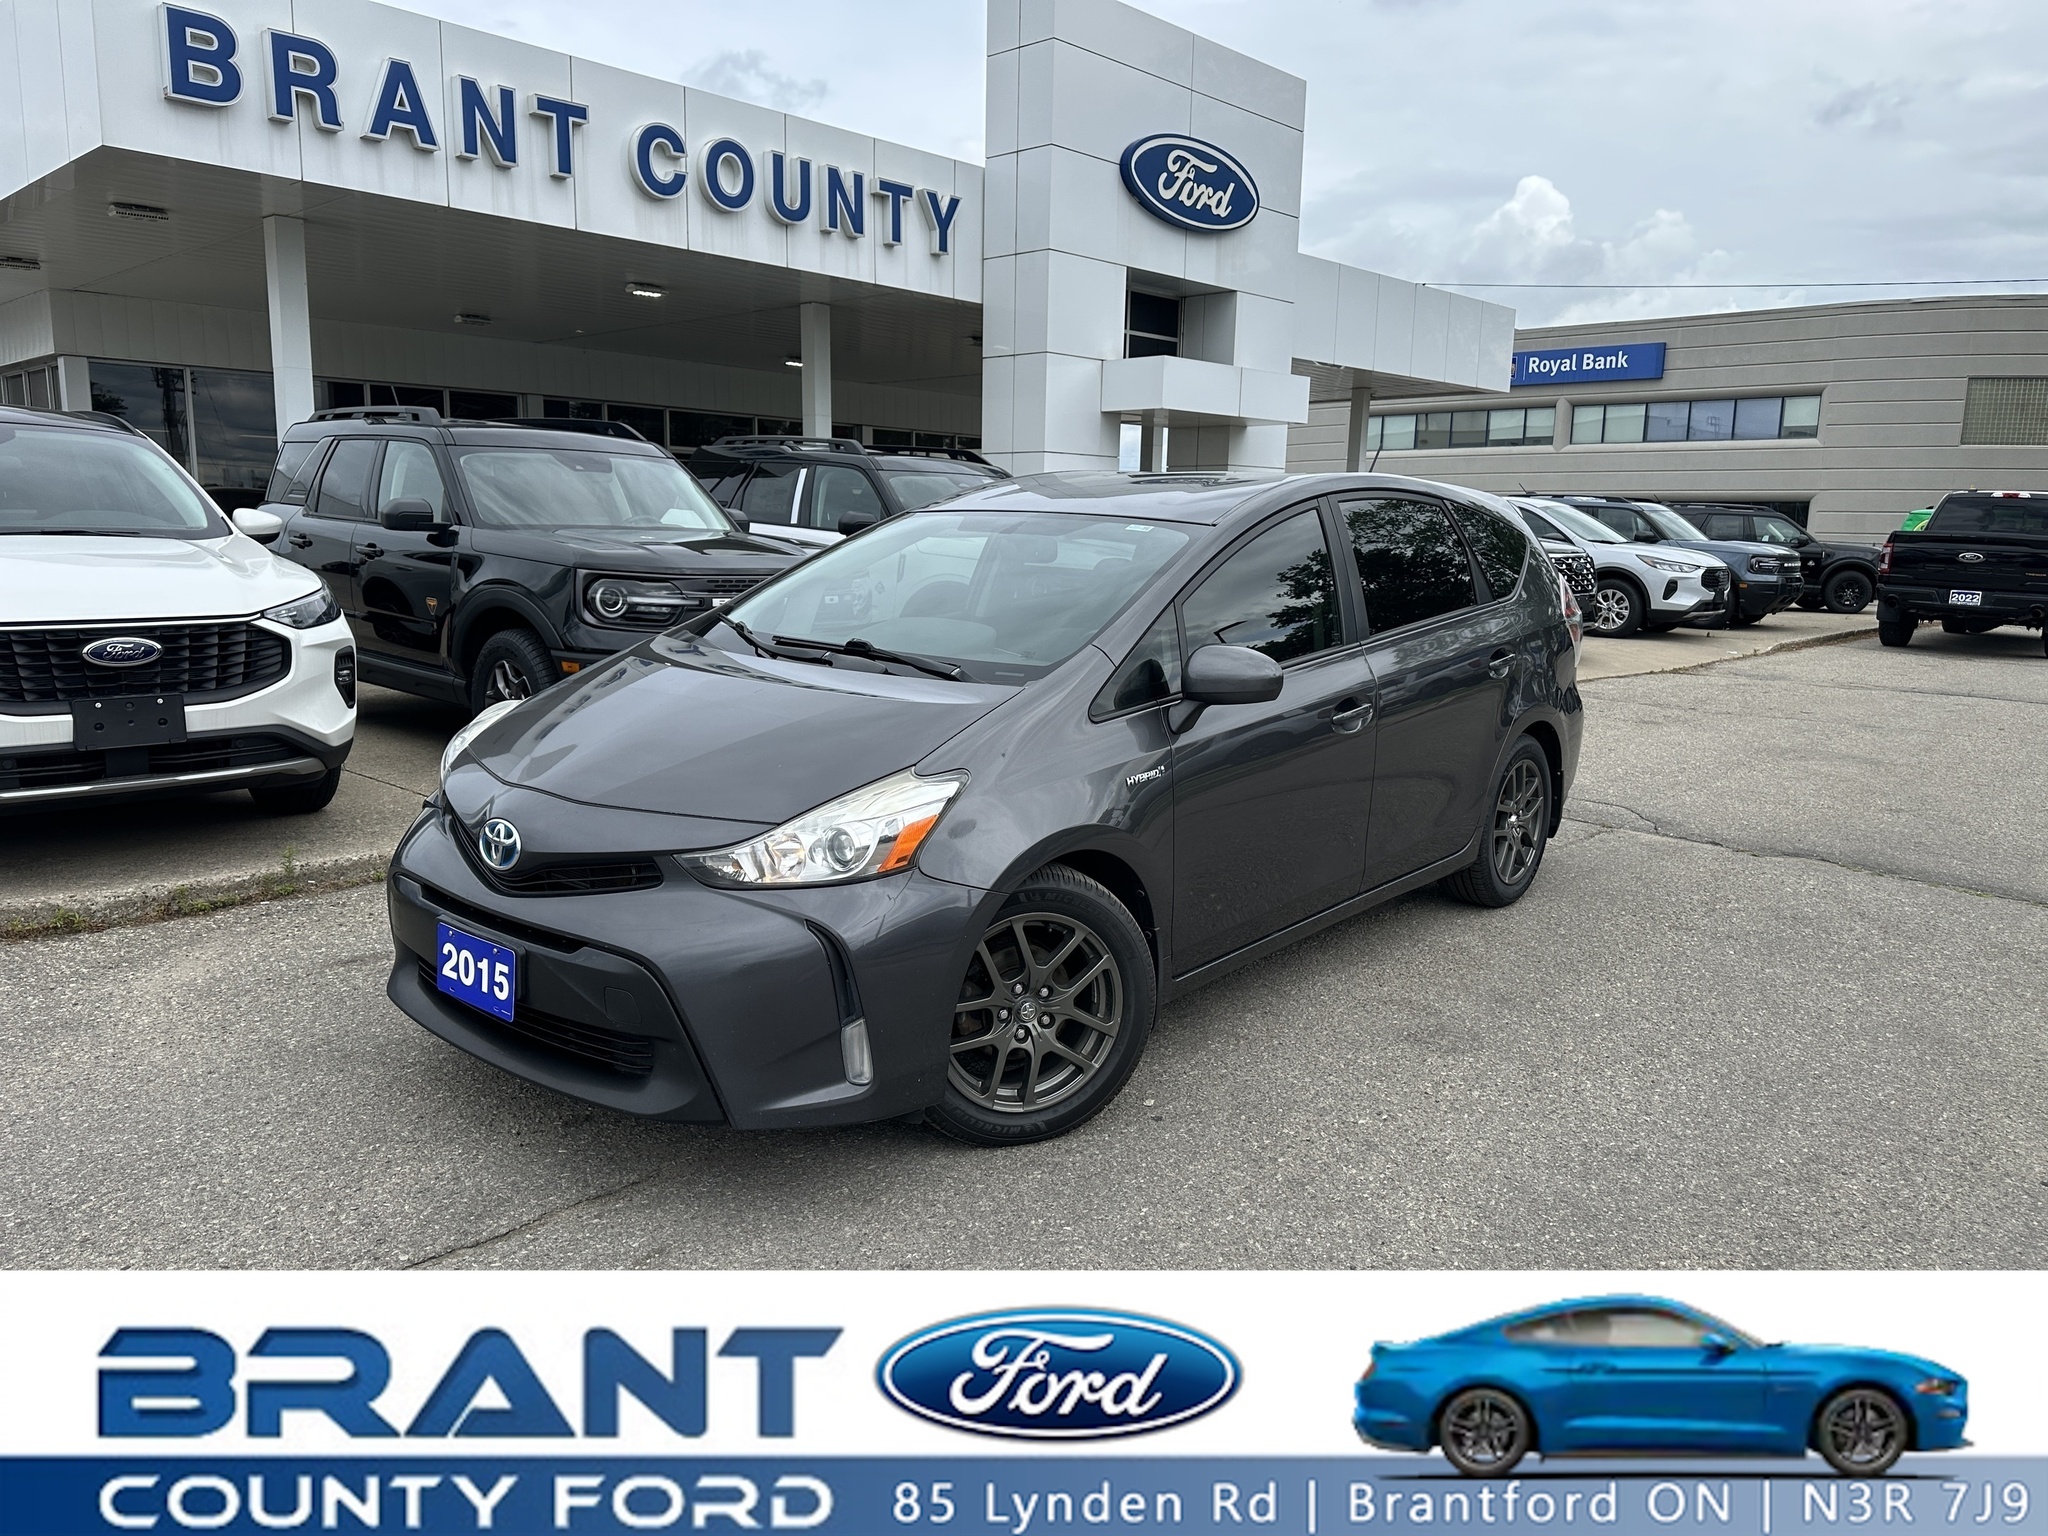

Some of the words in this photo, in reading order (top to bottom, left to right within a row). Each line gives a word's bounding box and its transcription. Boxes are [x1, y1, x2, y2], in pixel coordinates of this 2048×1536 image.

[157, 2, 589, 179] BRANT
[629, 122, 963, 256] COUNTY
[1158, 149, 1235, 218] Ford
[1528, 353, 1577, 377] Royal
[1582, 350, 1628, 371] Bank
[1951, 593, 1980, 603] 2022
[103, 643, 145, 659] Ford
[441, 942, 509, 1001] 2015
